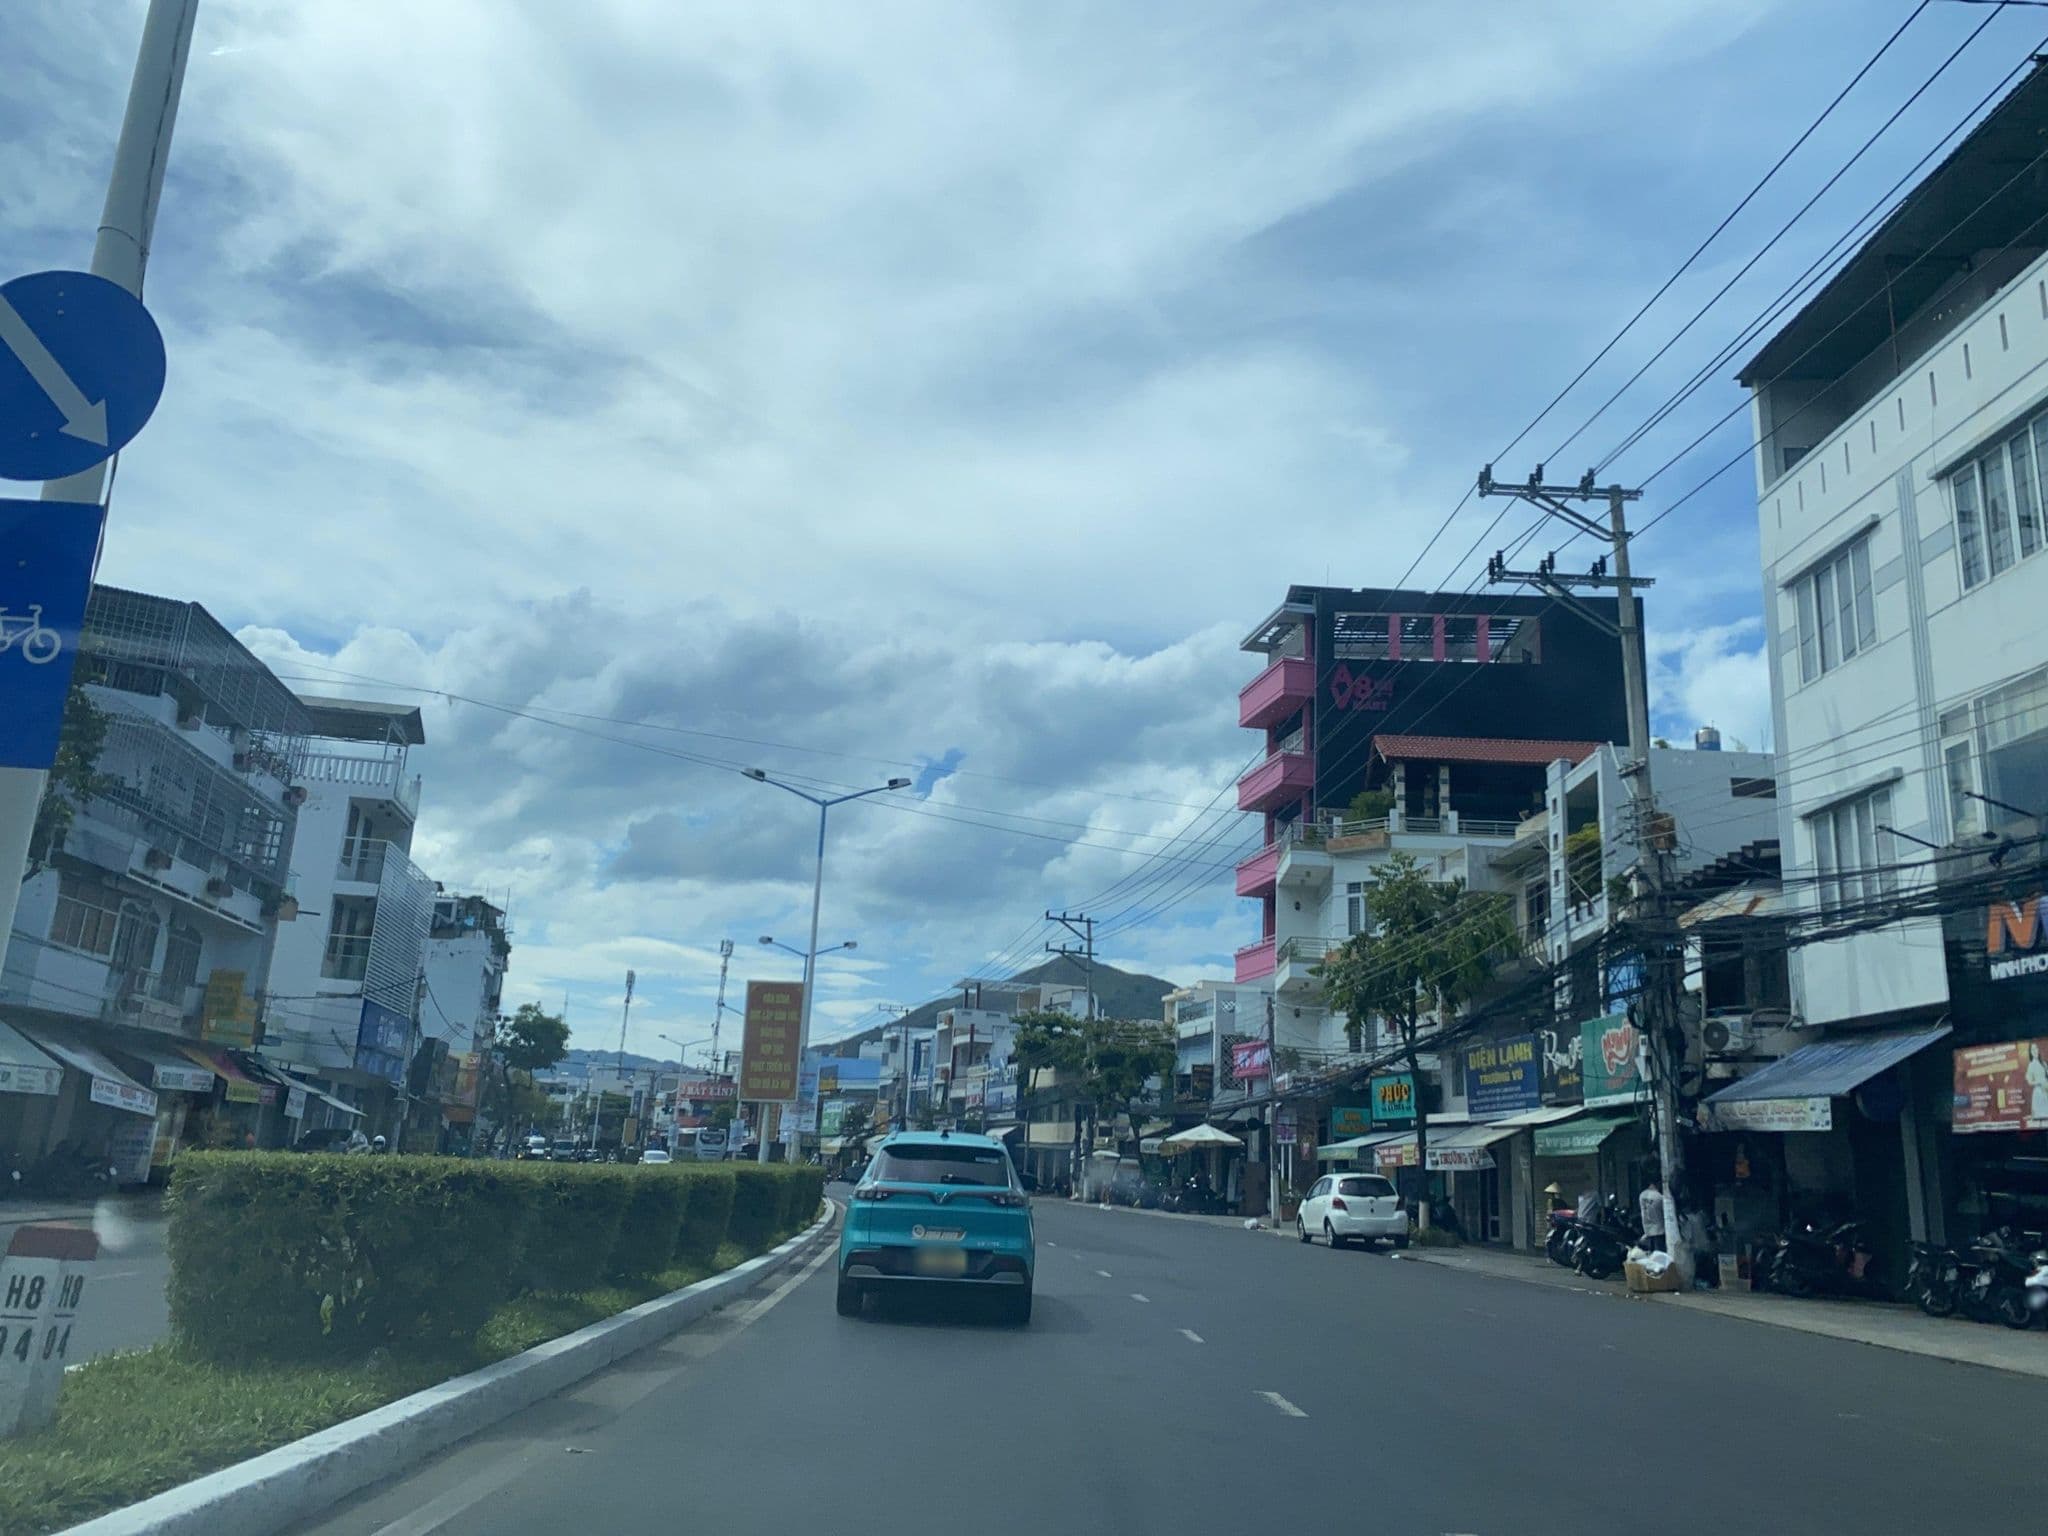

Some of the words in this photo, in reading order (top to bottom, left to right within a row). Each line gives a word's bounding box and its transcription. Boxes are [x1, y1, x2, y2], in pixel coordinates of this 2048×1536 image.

[5, 1274, 46, 1310] H8
[58, 1274, 85, 1309] H8
[42, 1324, 72, 1361] 04
